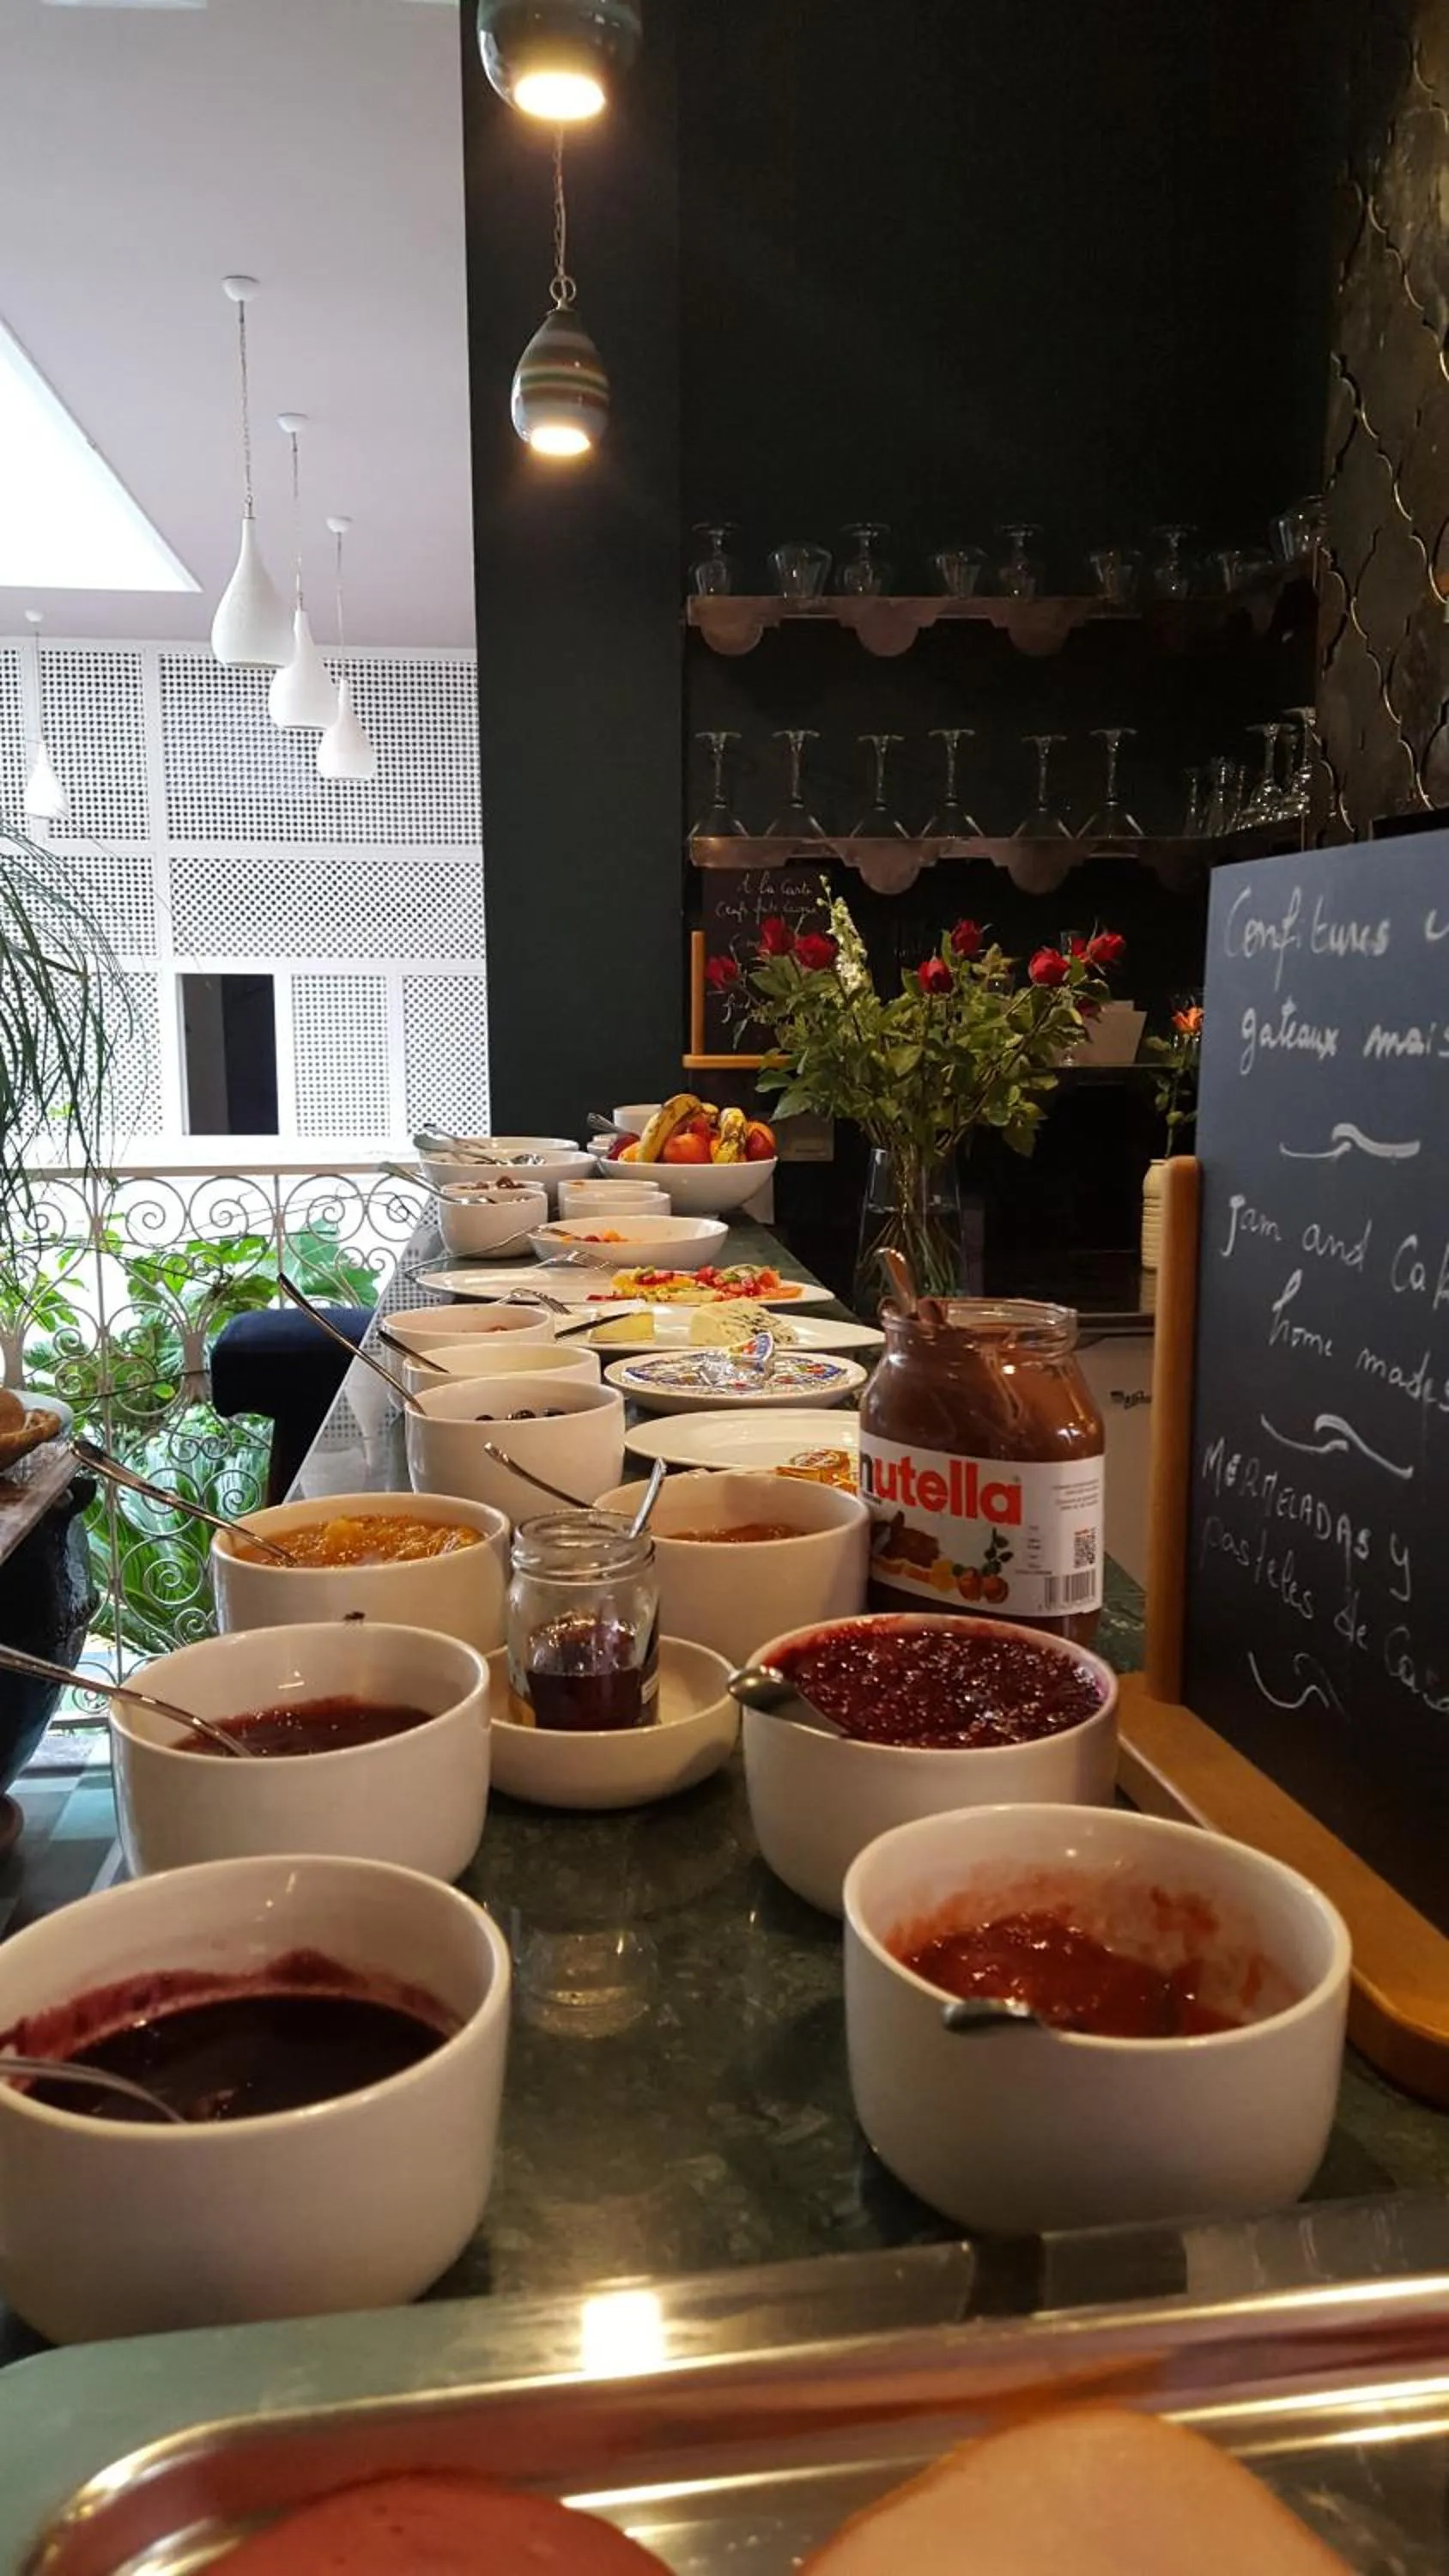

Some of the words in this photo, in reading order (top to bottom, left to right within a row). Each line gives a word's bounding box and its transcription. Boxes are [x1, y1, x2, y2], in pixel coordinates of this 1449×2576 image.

[1224, 886, 1391, 991] Confitures
[1302, 1218, 1372, 1273] and
[1268, 1268, 1333, 1357] home
[859, 1451, 1022, 1526] nutella
[1202, 1437, 1372, 1561] MERMELADAS
